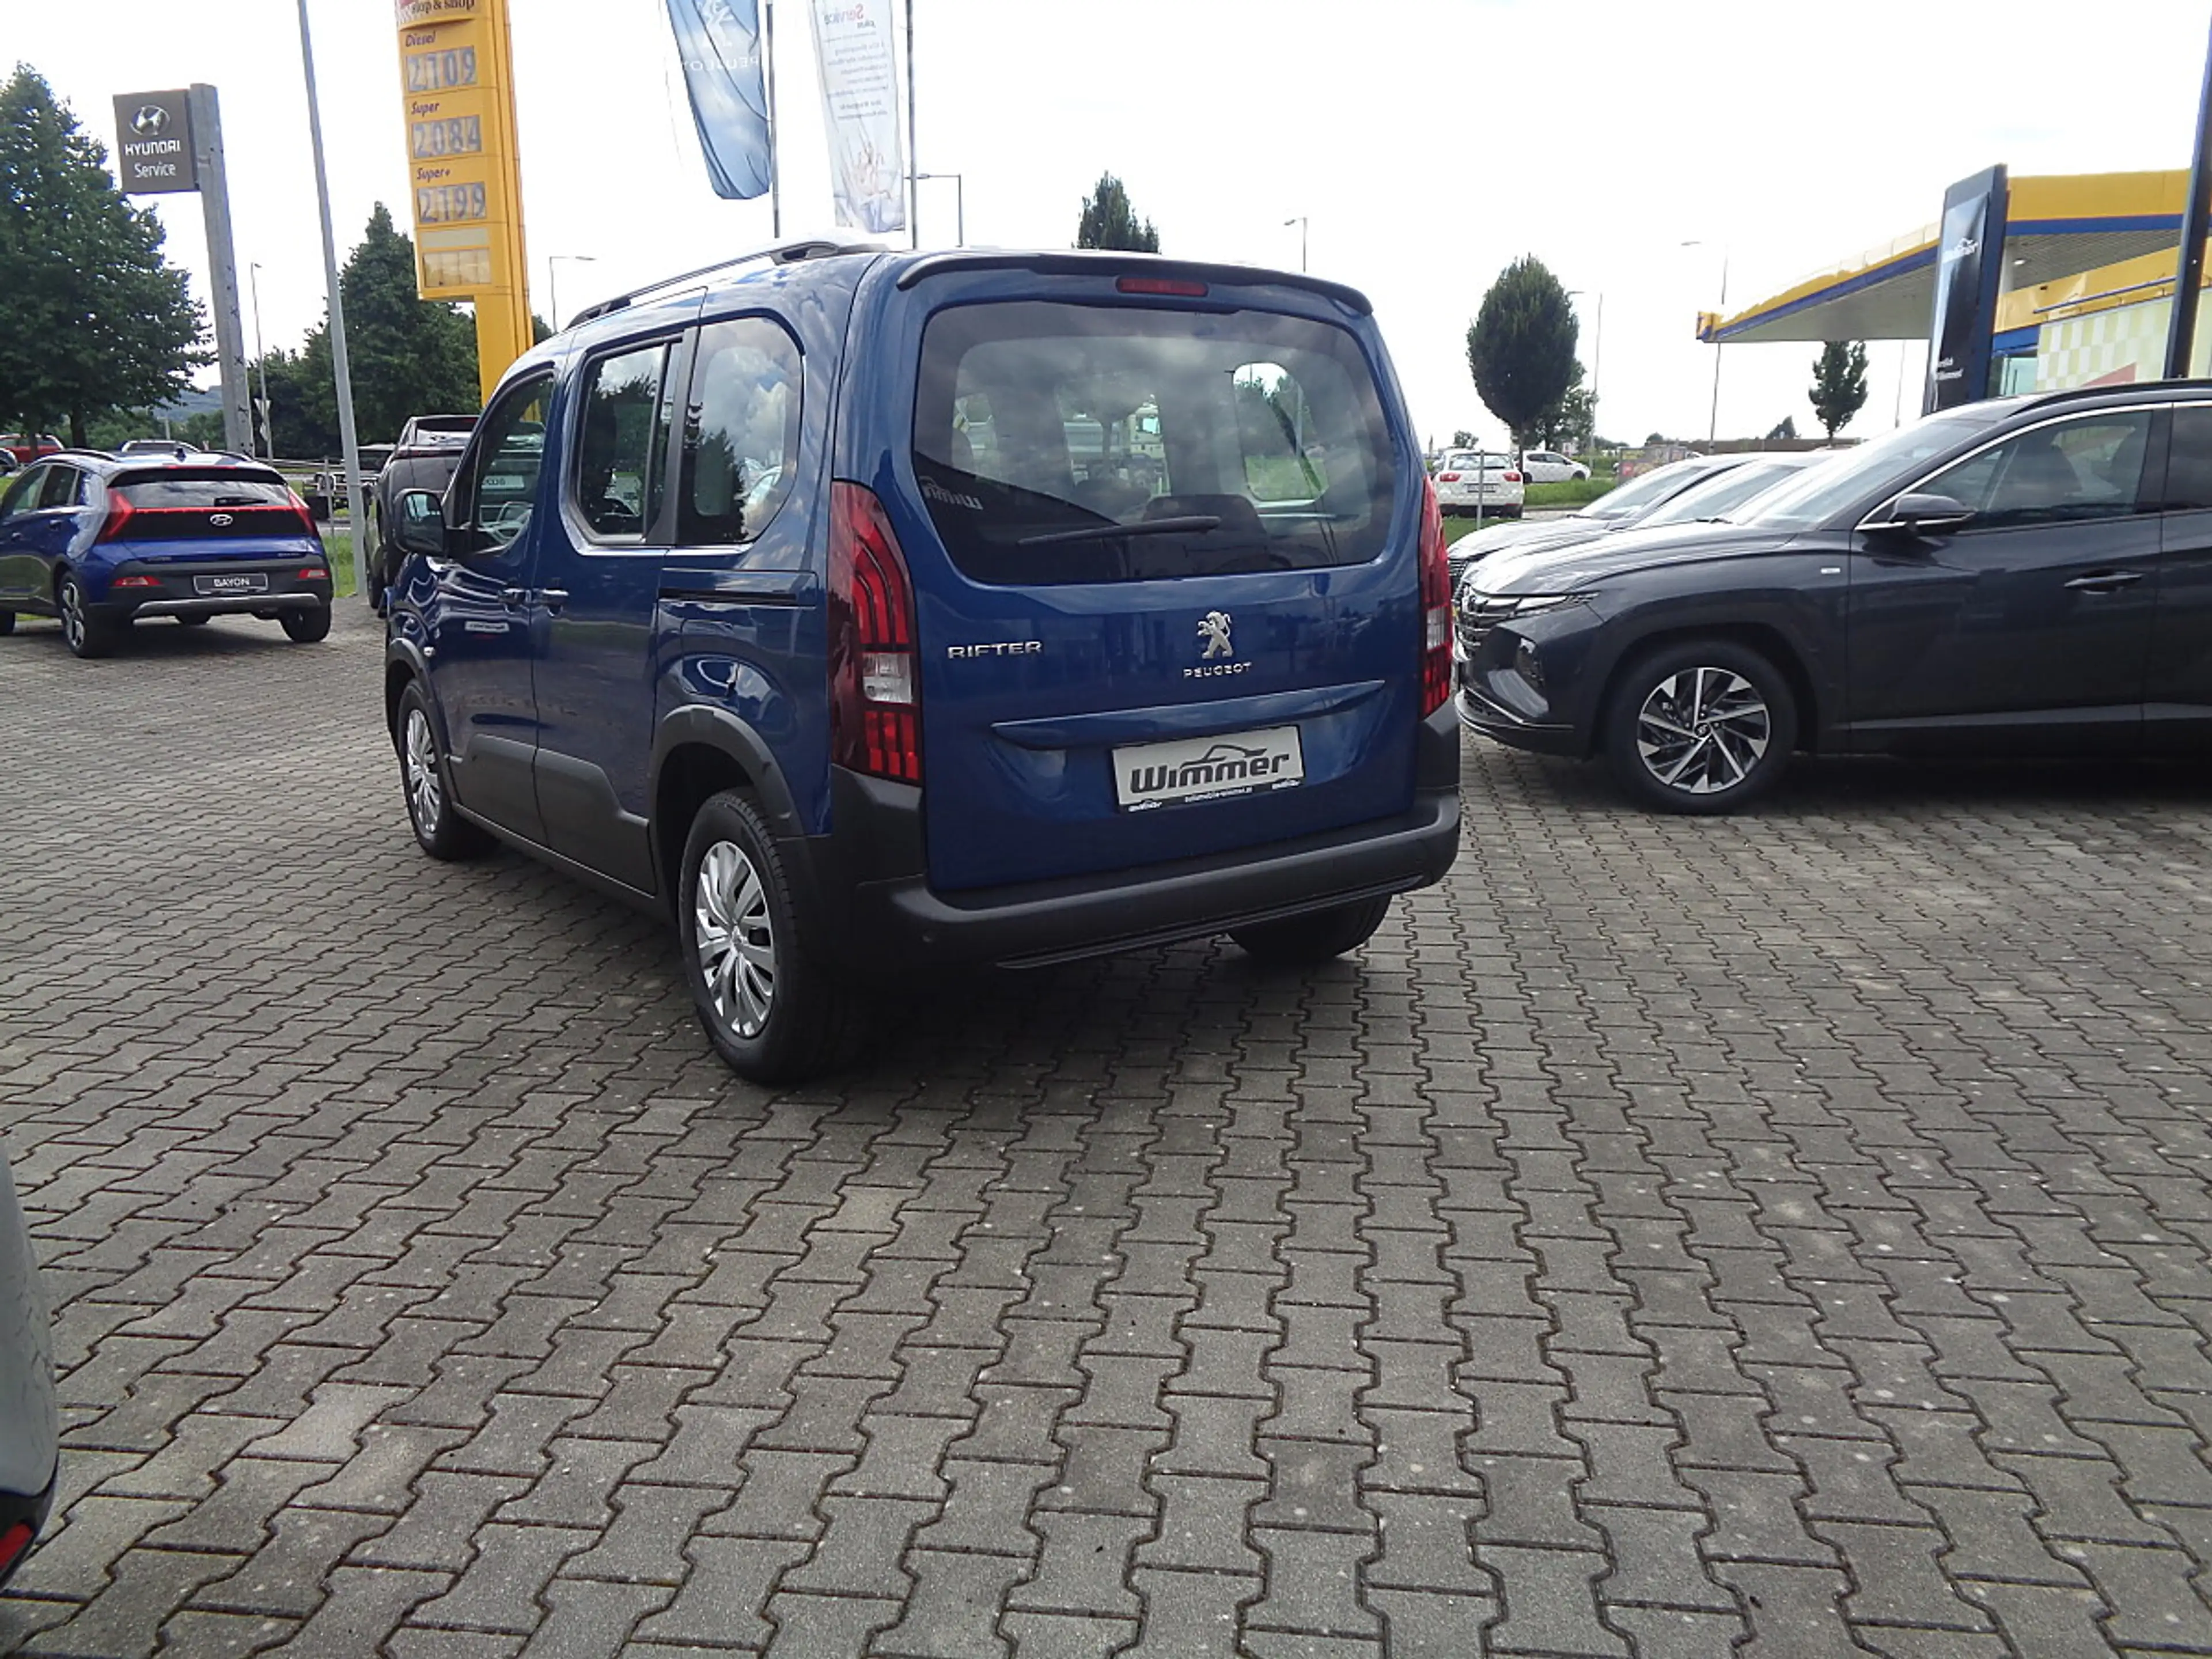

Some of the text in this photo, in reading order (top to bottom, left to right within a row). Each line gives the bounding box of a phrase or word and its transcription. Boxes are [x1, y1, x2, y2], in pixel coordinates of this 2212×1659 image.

[406, 30, 436, 47] Diesel
[411, 101, 440, 117] Super
[124, 139, 181, 156] HYUNDAI
[134, 159, 176, 177] Service
[417, 168, 450, 183] Super+
[214, 577, 250, 587] BAYON
[948, 641, 1041, 659] RIFTER
[1183, 661, 1252, 679] PEUGEOT
[1130, 753, 1290, 793] Wimmer
